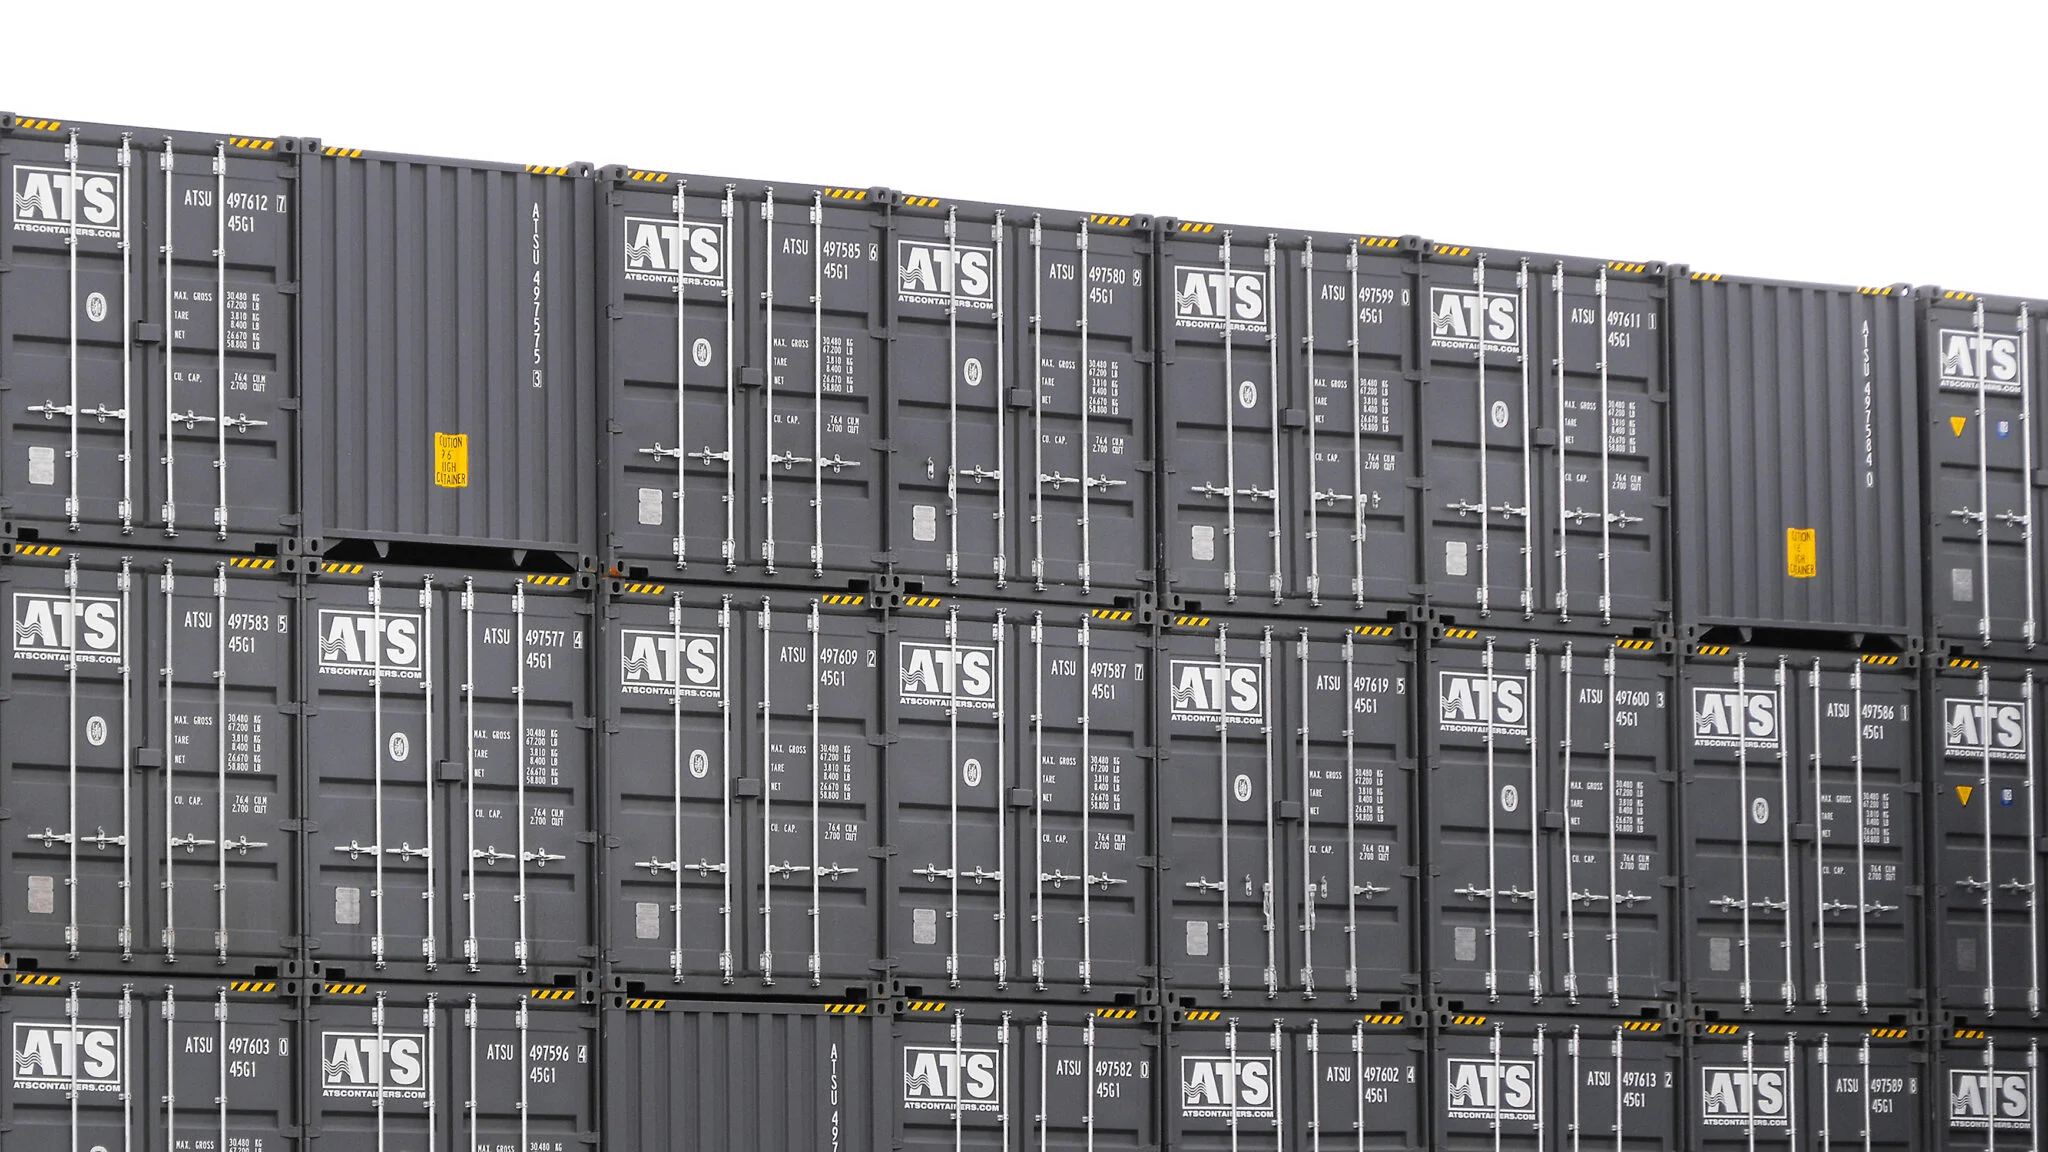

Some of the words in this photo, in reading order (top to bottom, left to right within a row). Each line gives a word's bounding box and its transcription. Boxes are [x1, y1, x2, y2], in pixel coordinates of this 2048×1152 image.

[19, 173, 115, 223] ATS
[185, 189, 212, 207] ATSU
[227, 192, 268, 211] 497612
[278, 196, 285, 211] 7
[14, 224, 120, 238] ATSCONTAIERS.COM
[228, 216, 254, 232] 45G1
[630, 224, 719, 273] ATS
[783, 238, 808, 255] ATSU
[823, 241, 860, 259] 497585
[870, 245, 877, 260] 6
[824, 263, 848, 280] 45G1
[903, 247, 988, 295] ATS
[1050, 263, 1074, 280] ATSU
[1089, 267, 1125, 284] 497580
[1134, 270, 1140, 285] 9
[625, 273, 724, 287] ATSCONTAIERS.COM
[174, 291, 188, 300] MAX.
[193, 292, 212, 301] GROSS
[227, 292, 247, 300] 30.480
[898, 295, 993, 309] ATSCONTAIERS.COM
[1090, 288, 1113, 304] 45G1
[1180, 273, 1262, 319] ATS
[1321, 284, 1345, 301] ATSU
[1359, 287, 1393, 304] 497599
[1402, 290, 1409, 305] 0
[227, 301, 247, 309] 67.200
[252, 302, 259, 310] LB
[175, 311, 189, 320] TARE
[231, 312, 247, 320] 3.810
[252, 313, 259, 321] KG
[1360, 308, 1382, 324] 45G1
[1435, 294, 1514, 340] ATS
[1572, 308, 1594, 324] ATSU
[1608, 311, 1640, 328] 497611
[231, 321, 247, 329] 8.400
[252, 322, 259, 330] LB
[175, 330, 185, 338] NET
[227, 331, 247, 340] 26.670
[252, 333, 259, 341] KG
[1608, 332, 1630, 347] 45G1
[227, 340, 247, 349] 58.800
[253, 342, 259, 350] LB
[1945, 336, 2017, 380] ATS
[188, 373, 202, 382] CAP.
[235, 373, 247, 381] 76.4
[231, 382, 247, 390] 2.700
[534, 371, 540, 386] 3
[1042, 377, 1055, 386] TARE
[1112, 380, 1118, 388] KG
[19, 600, 116, 649] ATS
[185, 611, 212, 628] ATSU
[228, 614, 268, 631] 497583
[279, 616, 286, 632] 5
[229, 636, 255, 653] 45G1
[324, 617, 416, 664] ATS
[484, 628, 510, 644] ATSU
[525, 630, 564, 647] 497577
[574, 632, 581, 648] 4
[14, 652, 120, 664] ATSCONTAIERS.COM
[526, 652, 552, 669] 45G1
[627, 637, 715, 684] ATS
[780, 646, 806, 663] ATSU
[820, 648, 857, 665] 497609
[868, 651, 875, 666] 2
[319, 667, 421, 679] ATSCONTAIERS.COM
[821, 670, 845, 686] 45G1
[905, 649, 990, 695] ATS
[1051, 660, 1076, 676] ATSU
[1091, 663, 1126, 679] 497587
[1136, 665, 1142, 679] 7
[622, 686, 720, 698] ATSCONTAIERS.COM
[1092, 684, 1115, 700] 45G1
[1175, 666, 1257, 712] ATS
[1317, 675, 1340, 691] ATSU
[1354, 677, 1388, 693] 497619
[1397, 679, 1404, 693] 5
[1355, 698, 1377, 714] 45G1
[1444, 678, 1523, 723] ATS
[1580, 689, 1603, 704] ATSU
[1616, 691, 1649, 706] 497600
[1616, 711, 1638, 726] 45G1
[1699, 694, 1774, 736] ATS
[1828, 703, 1850, 718] ATSU
[1862, 704, 1894, 720] 497586
[1863, 725, 1884, 740] 45G1
[1950, 704, 2022, 747] ATS
[771, 763, 784, 772] TARE
[824, 763, 839, 771] 3.810
[19, 1030, 115, 1078] ATS
[185, 1037, 212, 1053] ATSU
[229, 1038, 269, 1055] 497603
[280, 1038, 287, 1055] 0
[487, 1044, 513, 1060] ATSU
[530, 1046, 569, 1062] 497596
[579, 1046, 586, 1062] 4
[229, 1061, 256, 1078] 45G1
[328, 1039, 420, 1085] ATS
[1057, 1060, 1081, 1076] ATSU
[1096, 1061, 1132, 1077] 497582
[1141, 1062, 1148, 1077] 0
[530, 1067, 556, 1083] 45G1
[909, 1054, 994, 1098] ATS
[1327, 1067, 1350, 1082] ATSU
[1364, 1067, 1399, 1082] 497602
[1408, 1067, 1414, 1082] 4
[1588, 1071, 1610, 1086] ATSU
[1623, 1072, 1656, 1088] 497613
[13, 1082, 120, 1092] ATSCONTAIERS.COM
[1097, 1082, 1120, 1098] 45G1
[1187, 1062, 1268, 1105] ATS
[1453, 1065, 1531, 1107] ATS
[1837, 1078, 1859, 1093] ATSU
[1871, 1079, 1903, 1093] 497589
[323, 1089, 426, 1099] ATSCONTAIERS.COM
[1365, 1088, 1387, 1103] 45G1
[1624, 1093, 1645, 1107] 45G1
[1708, 1073, 1783, 1113] ATS
[1954, 1075, 2027, 1117] ATS
[904, 1102, 999, 1112] ATSCONTAIERS.COM
[1183, 1110, 1274, 1118] ATSCONTAIERS.COM
[1872, 1099, 1893, 1113] 45G1
[176, 1141, 190, 1149] MAX.
[195, 1141, 214, 1149] GROSS
[229, 1138, 249, 1147] 30.480
